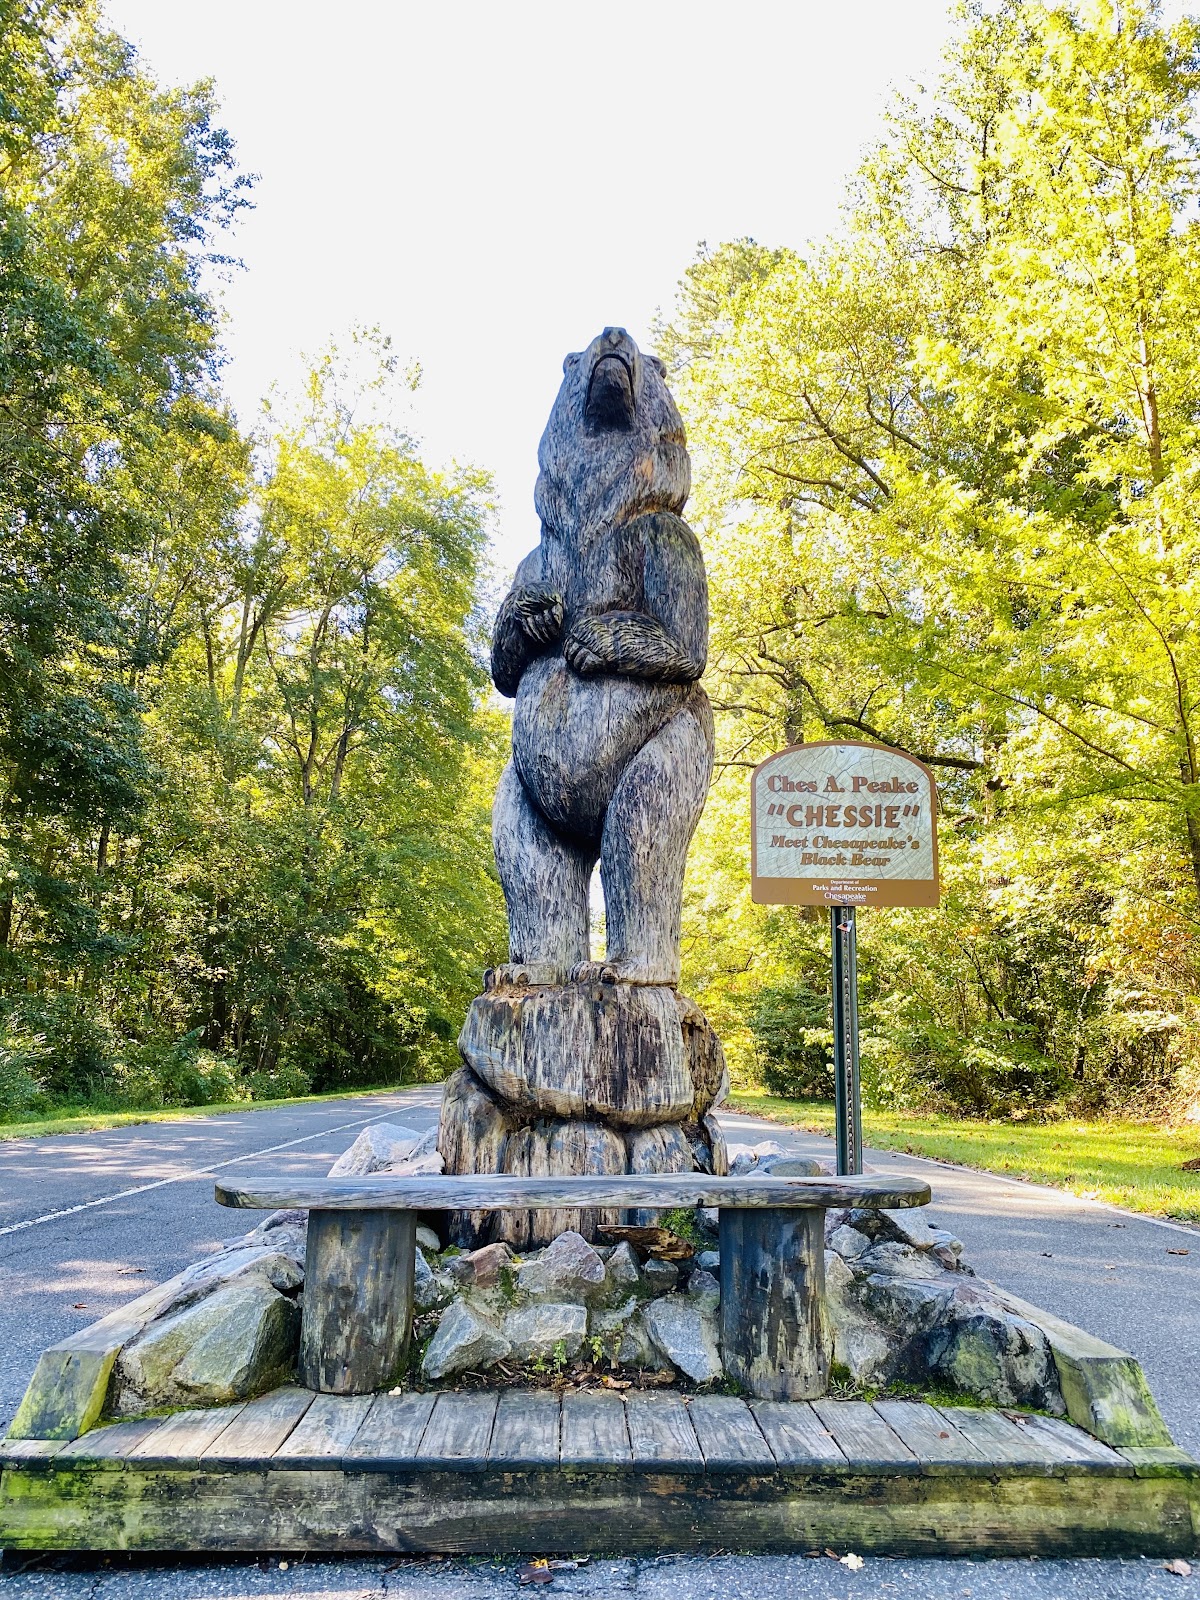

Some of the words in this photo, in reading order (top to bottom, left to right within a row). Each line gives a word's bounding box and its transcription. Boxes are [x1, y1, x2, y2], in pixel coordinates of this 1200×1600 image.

[767, 775, 818, 793] Ches
[823, 776, 845, 792] A.
[852, 776, 919, 793] Peake
[767, 804, 920, 828] "CHESSIE"
[770, 836, 808, 848] Meet
[812, 835, 920, 852] Chesapeake's
[800, 852, 847, 866] Black
[850, 854, 890, 867] Bear
[824, 892, 866, 900] Chesapeake
